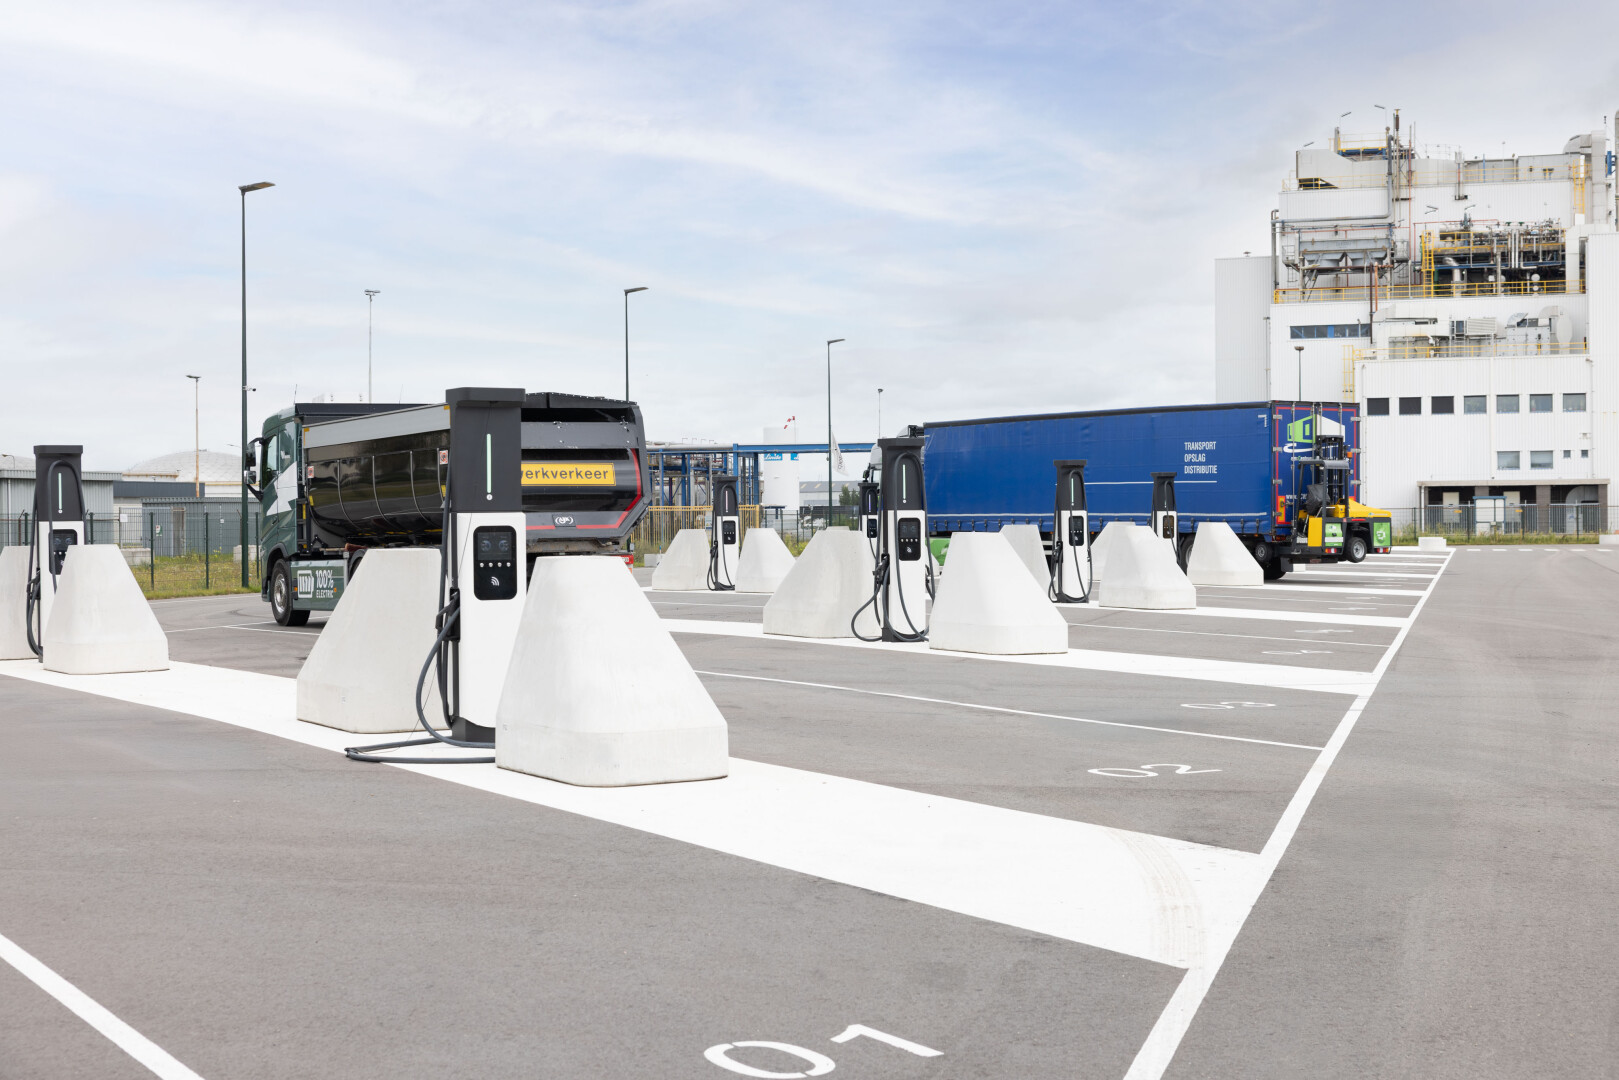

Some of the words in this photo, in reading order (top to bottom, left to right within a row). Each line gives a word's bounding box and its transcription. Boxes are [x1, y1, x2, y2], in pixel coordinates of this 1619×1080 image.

[1184, 441, 1217, 450] TRANSPORT
[1184, 453, 1206, 462] OPSLAG
[1184, 465, 1218, 474] DISTRIBUTIE
[315, 570, 334, 588] 100%
[316, 589, 334, 598] ELECTRIC
[1087, 763, 1223, 778] 02
[703, 1024, 944, 1079] 01
